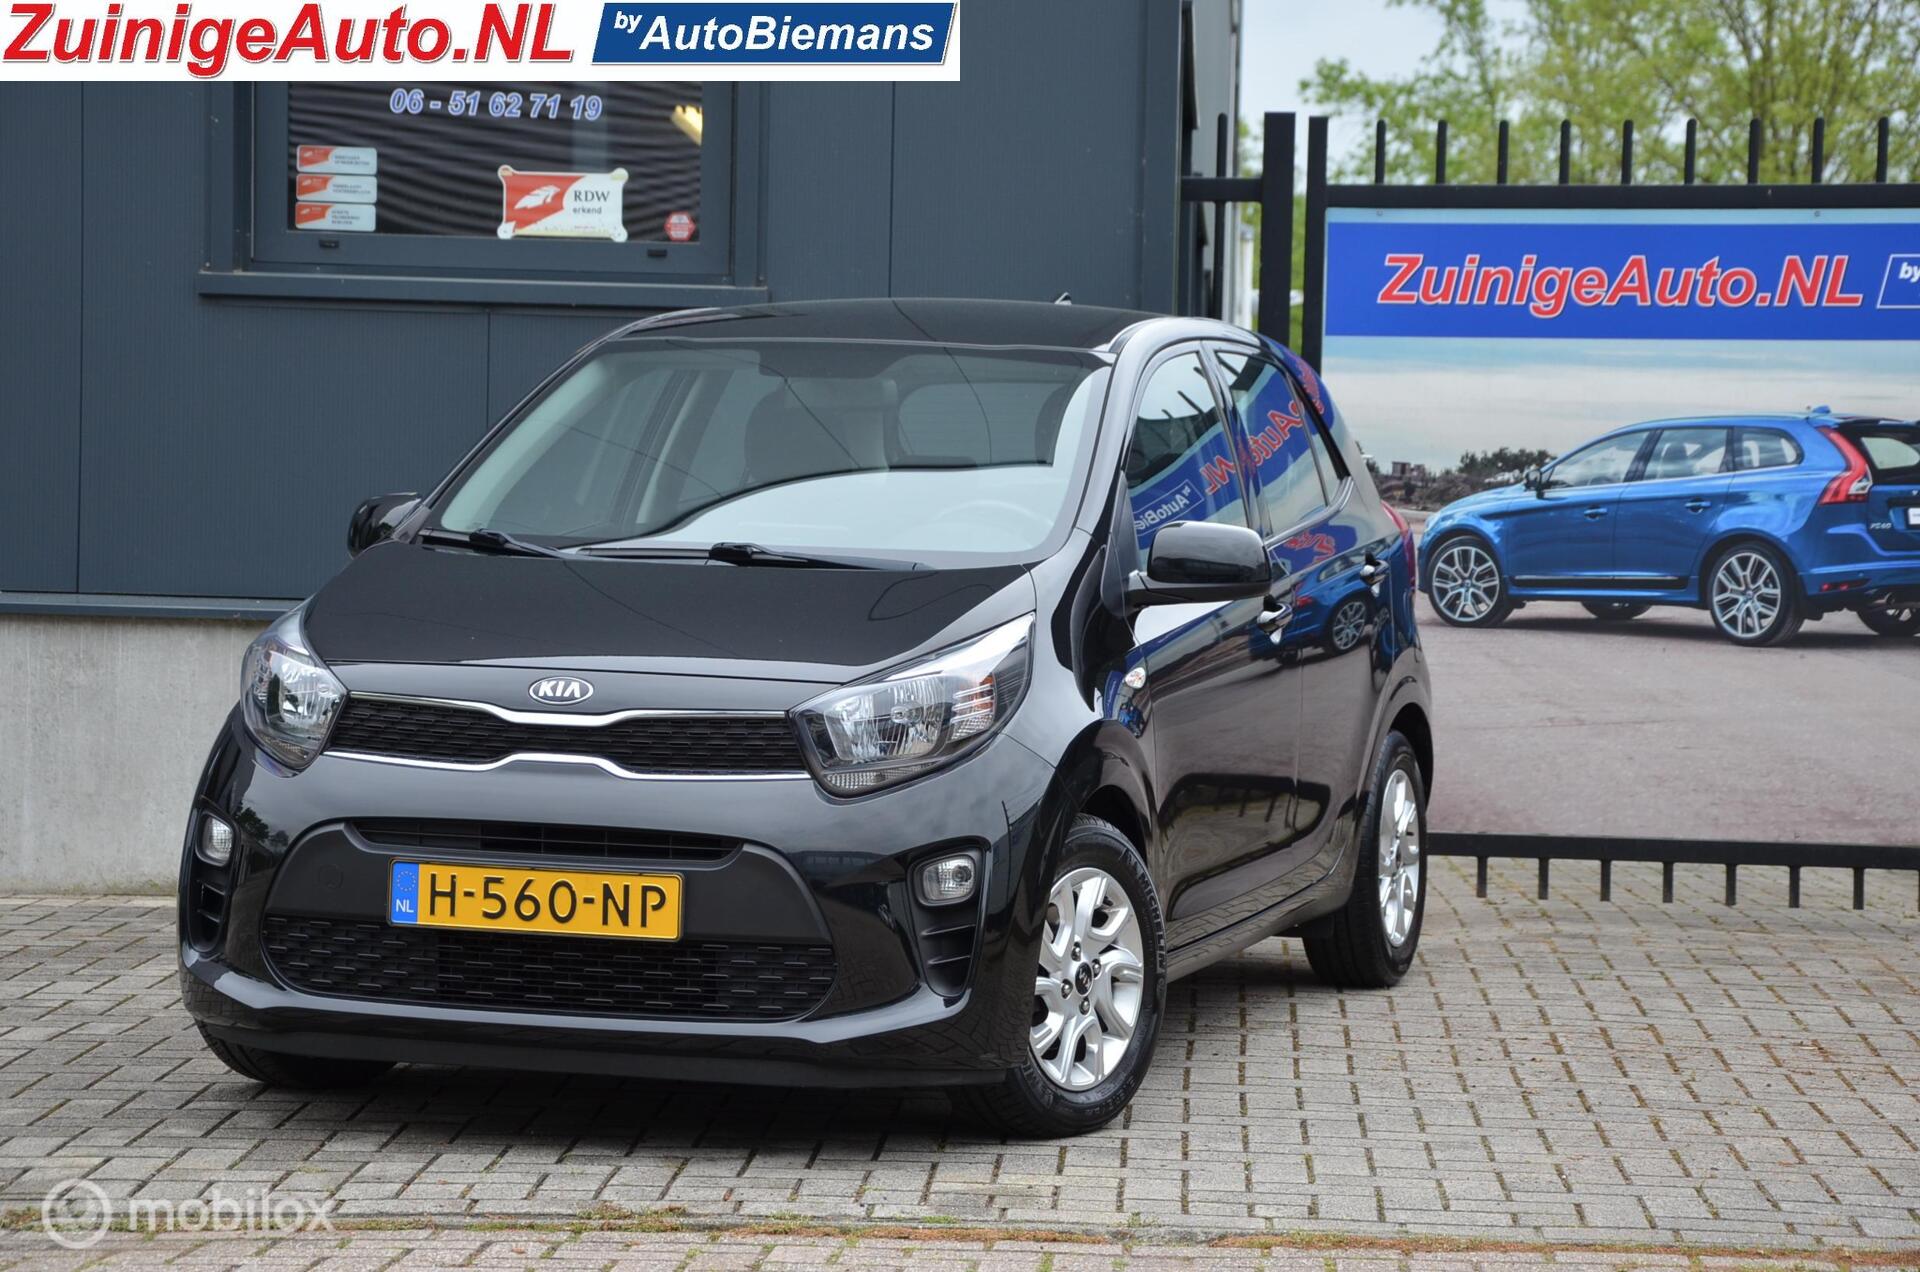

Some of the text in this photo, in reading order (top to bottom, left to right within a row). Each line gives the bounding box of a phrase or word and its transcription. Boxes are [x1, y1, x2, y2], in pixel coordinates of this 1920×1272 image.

[390, 88, 425, 115] 06
[448, 90, 481, 116] 51
[488, 92, 522, 117] 62
[530, 93, 561, 119] 71
[570, 95, 603, 120] 19
[574, 189, 610, 202] RDW
[572, 206, 602, 215] erkend
[1377, 253, 1863, 319] ZuinigeAuto.NL
[538, 680, 580, 698] KIA
[396, 899, 414, 913] NL
[429, 872, 666, 928] H-560-NP
